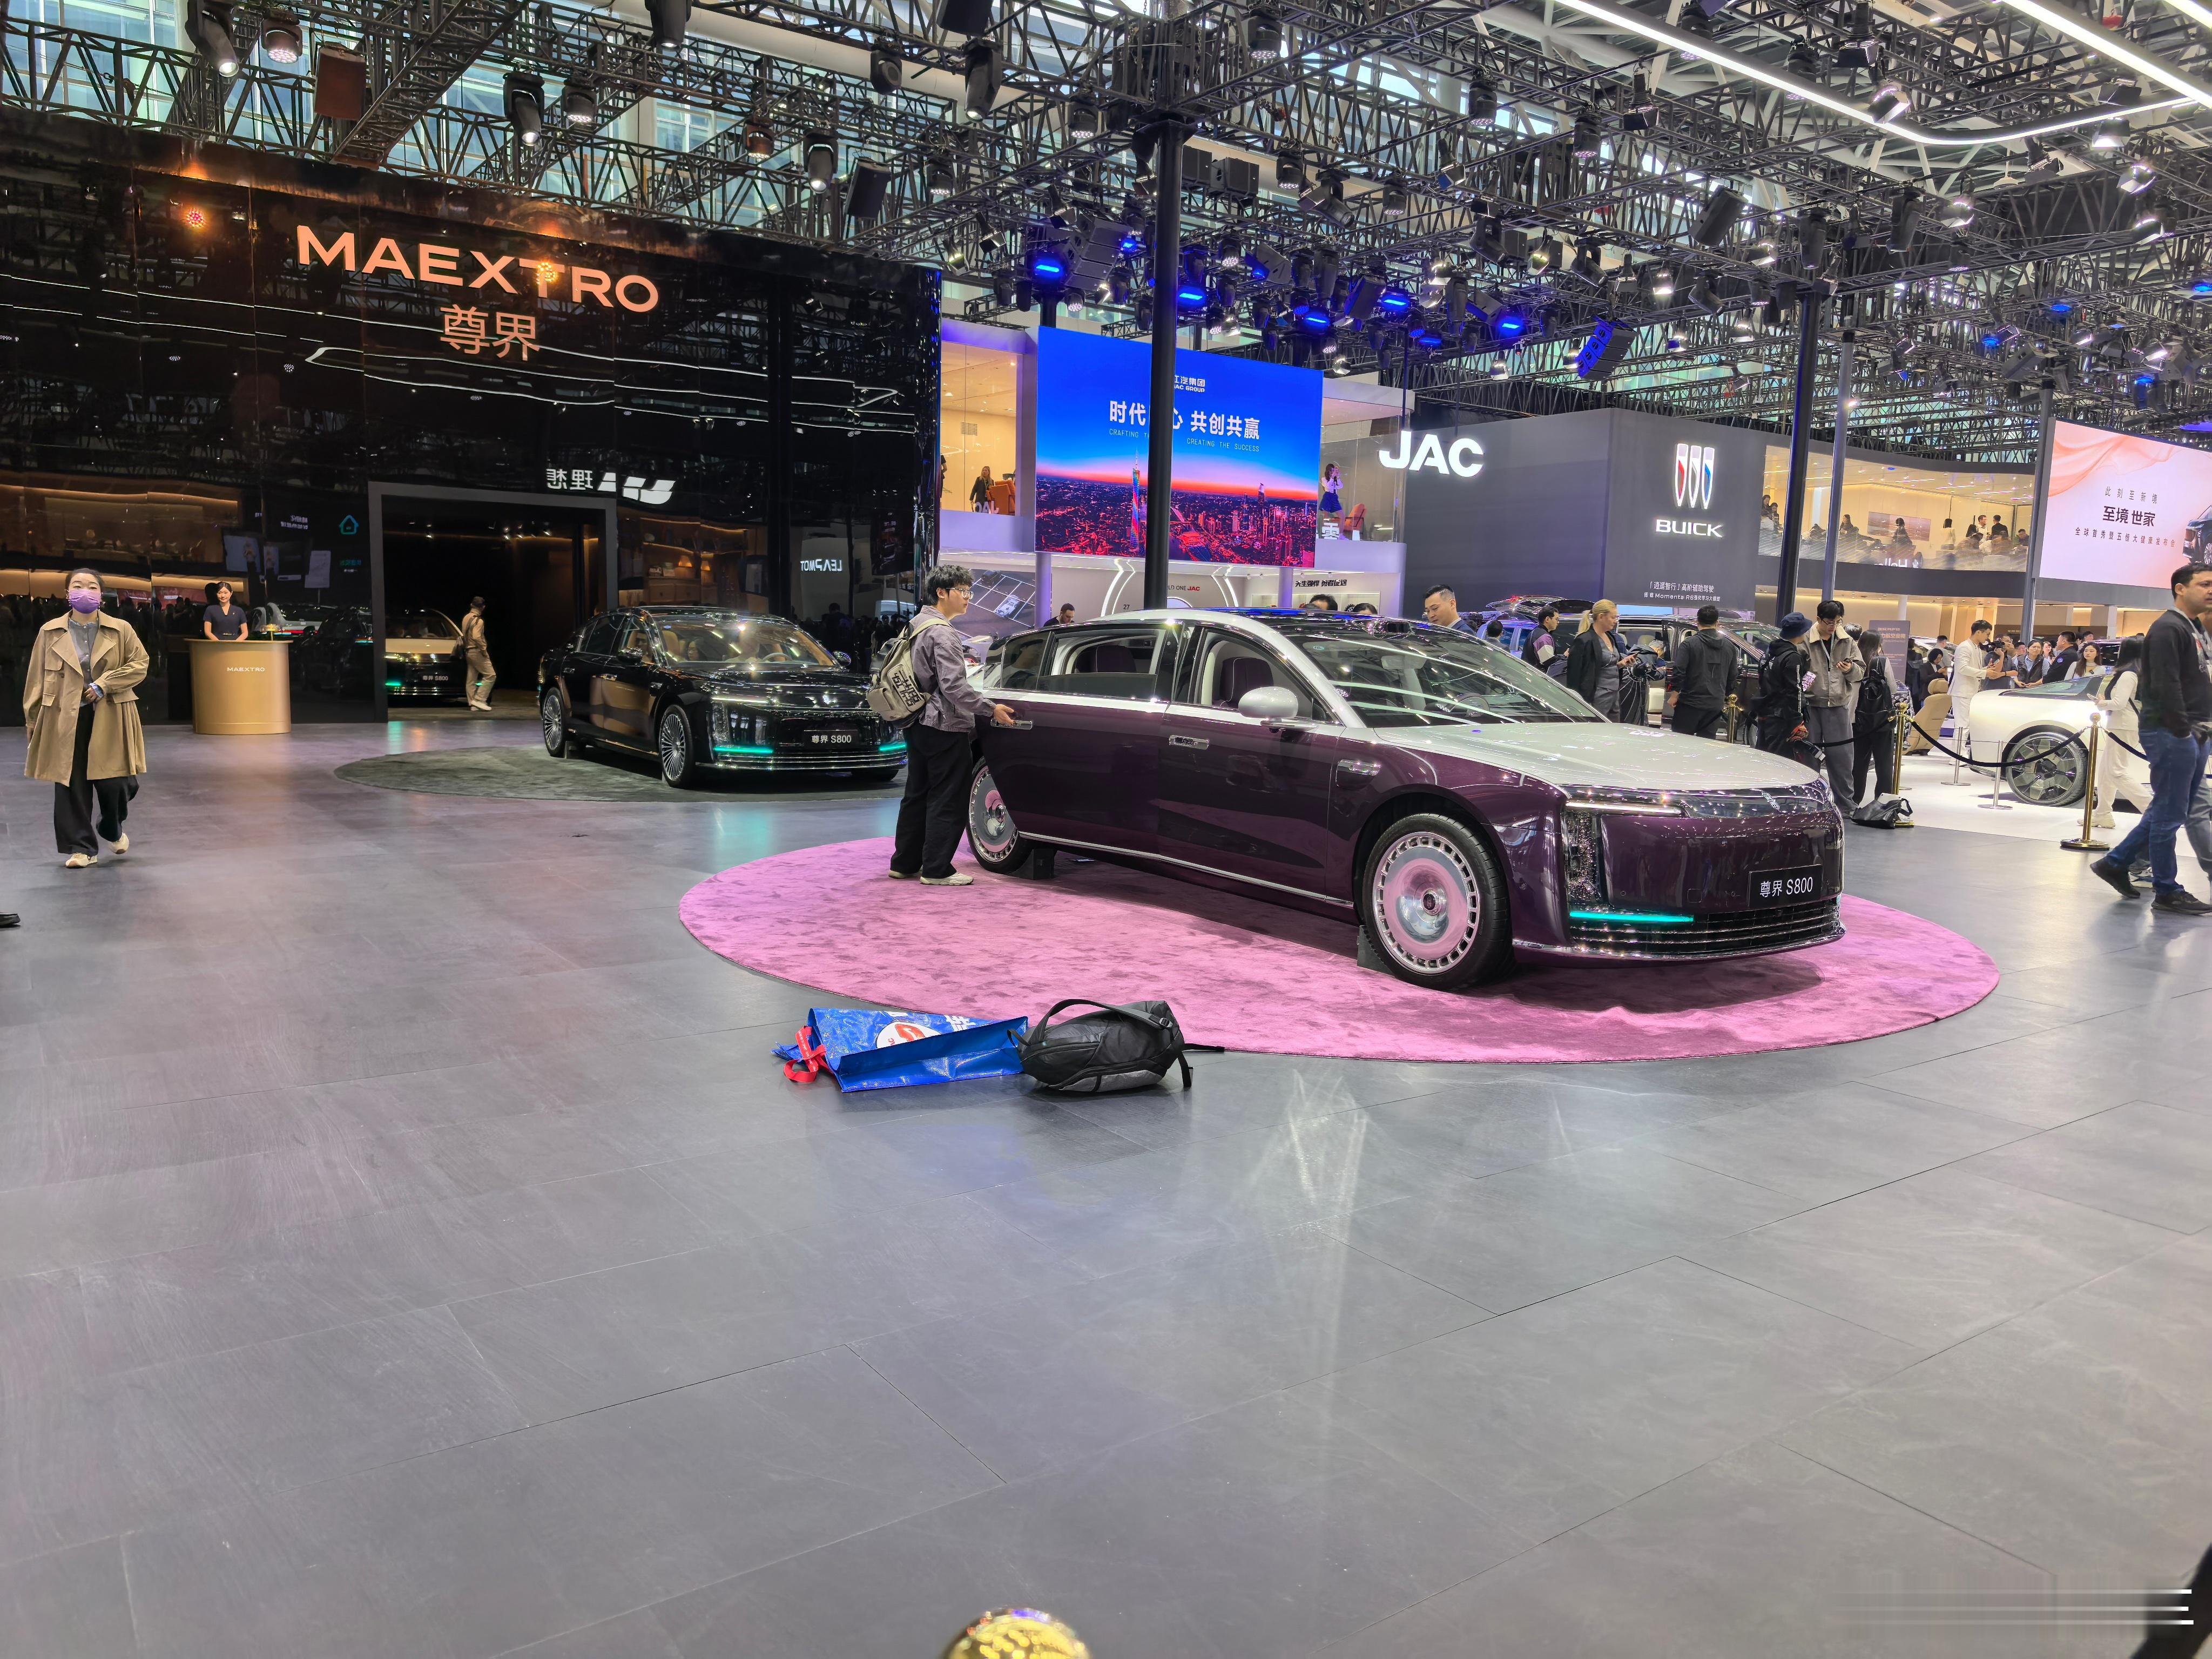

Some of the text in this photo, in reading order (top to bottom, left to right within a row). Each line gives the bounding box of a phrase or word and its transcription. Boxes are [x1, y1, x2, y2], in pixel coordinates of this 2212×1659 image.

[296, 225, 659, 312] MAEXTRO
[440, 305, 540, 361] 尊界
[1109, 428, 1139, 438] CRAFTING
[1190, 410, 1260, 440] 共创共赢
[1187, 438, 1215, 447] CREATING
[1234, 443, 1259, 452] SUCCESS
[1379, 430, 1484, 477] JAC
[2105, 486, 2158, 504] 此刻至新境
[1656, 519, 1722, 537] BUICK
[811, 735, 852, 744] 尊界 S800
[1760, 876, 1813, 898] 尊界 S800
